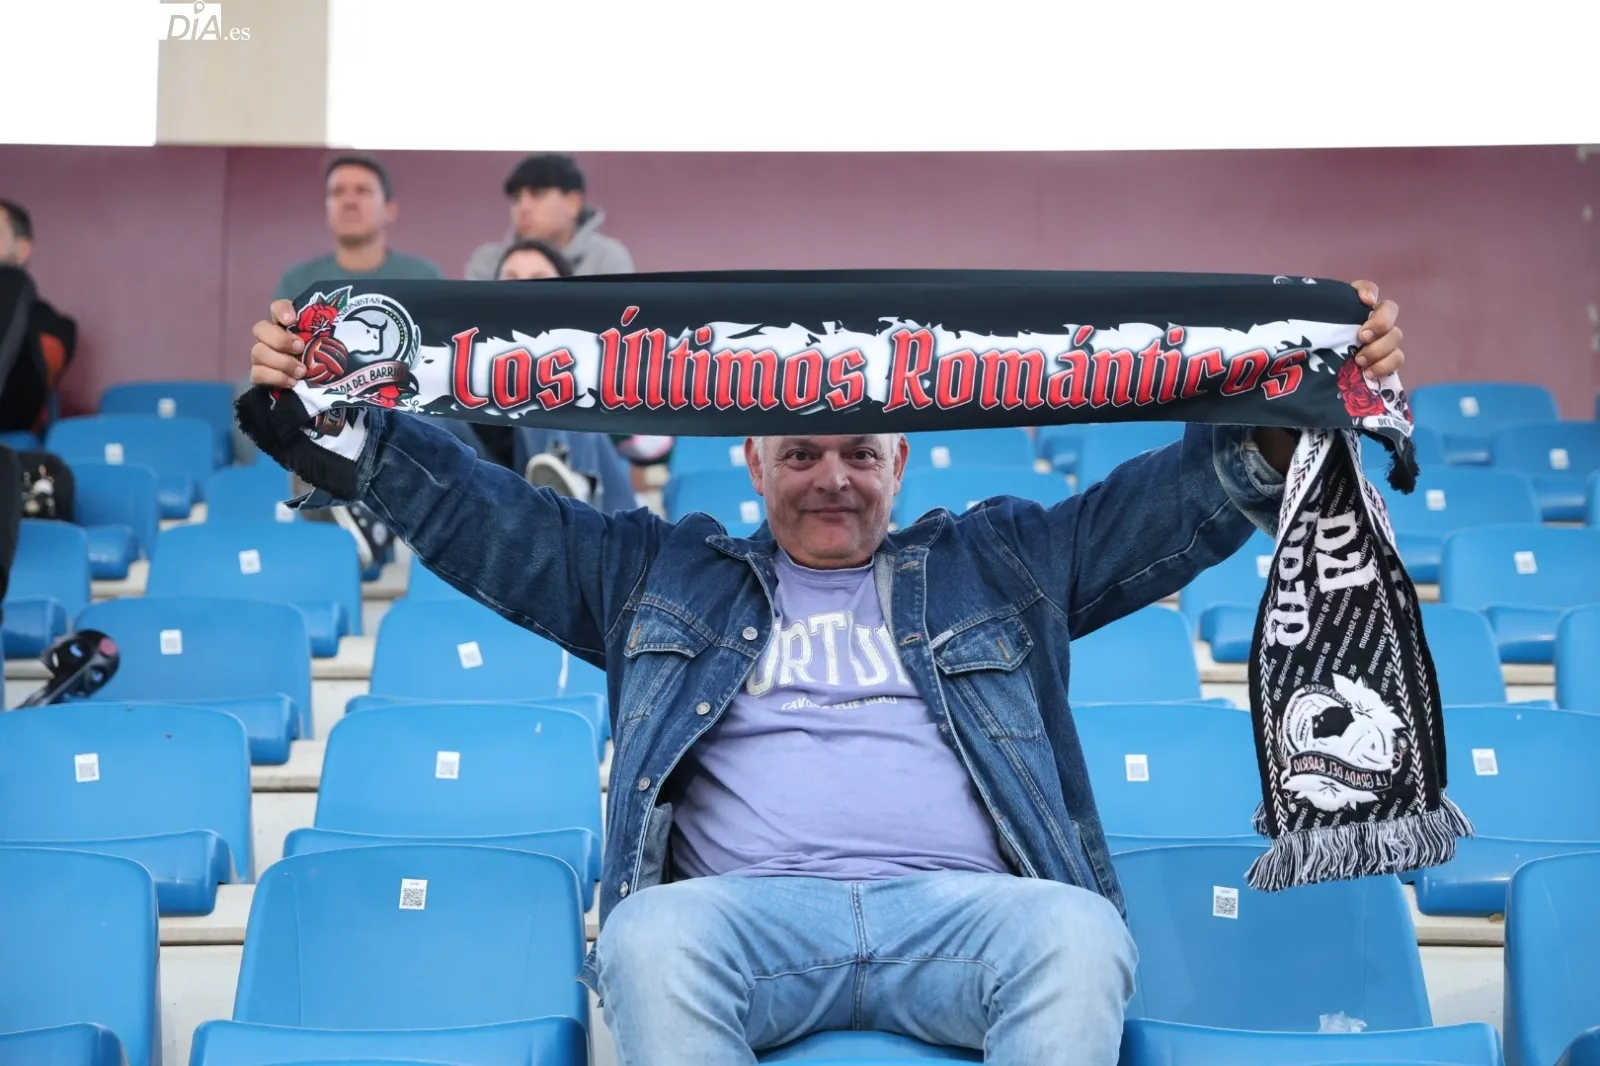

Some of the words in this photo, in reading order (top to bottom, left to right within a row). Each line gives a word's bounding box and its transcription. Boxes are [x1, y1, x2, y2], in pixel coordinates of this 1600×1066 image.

[352, 374, 369, 389] DEL
[451, 326, 577, 412] Los
[598, 305, 866, 412] Últimos
[882, 325, 1309, 414] Románticos
